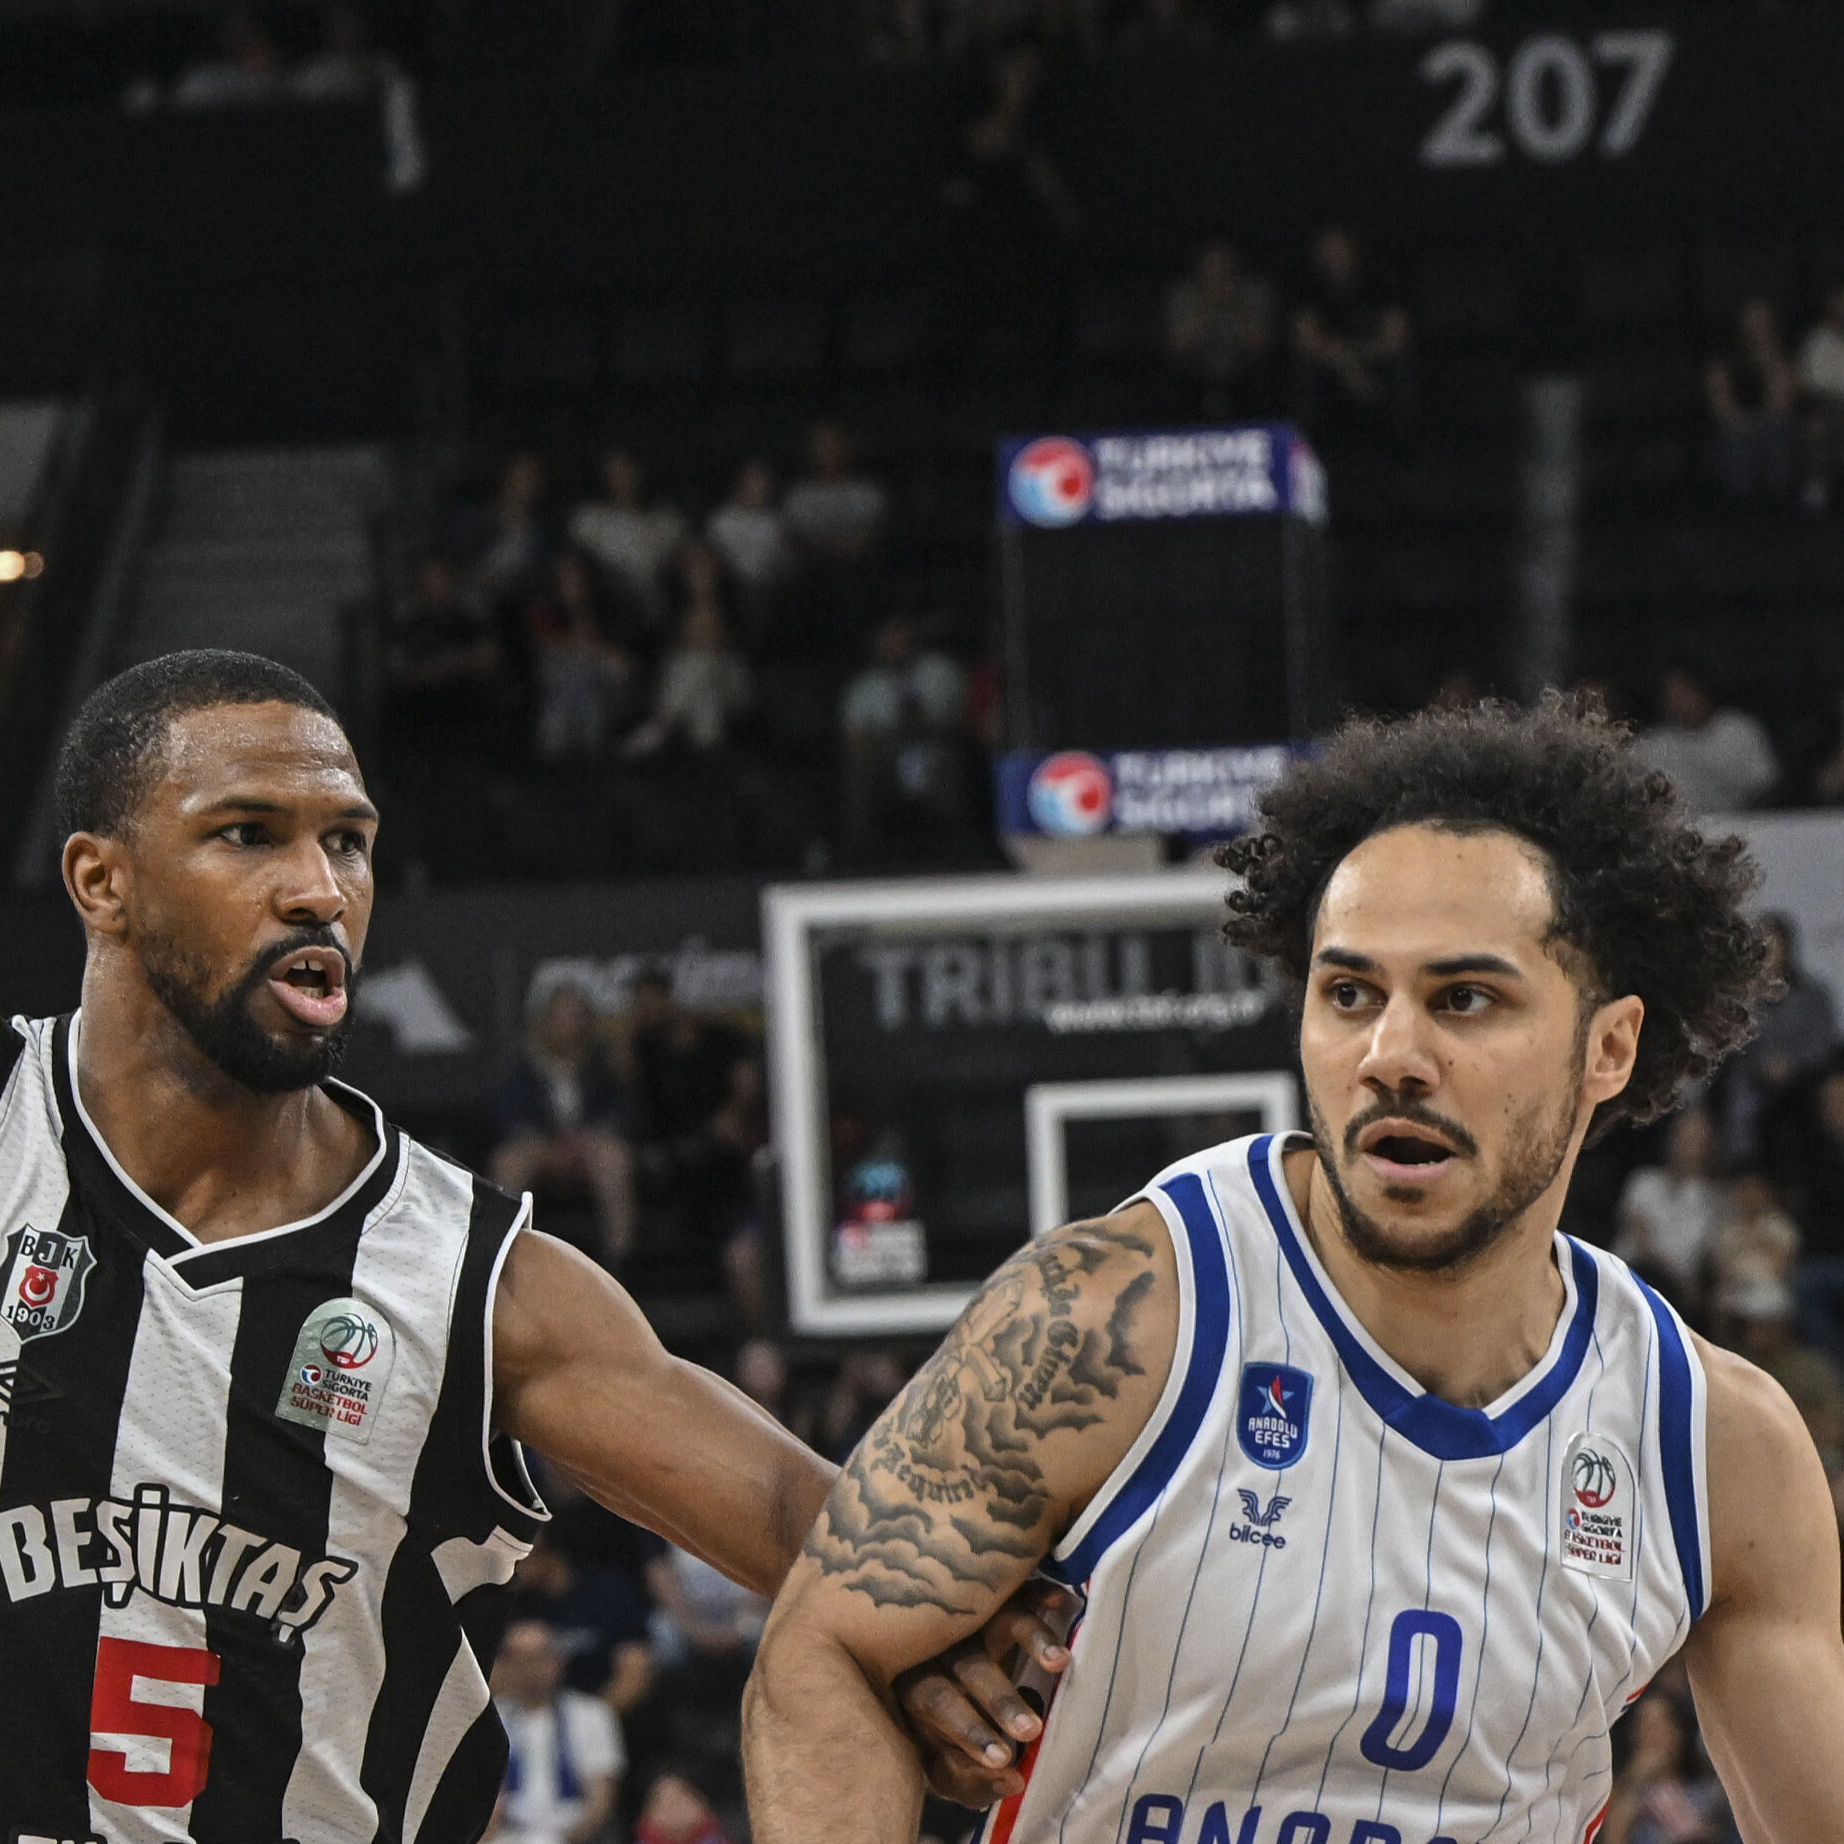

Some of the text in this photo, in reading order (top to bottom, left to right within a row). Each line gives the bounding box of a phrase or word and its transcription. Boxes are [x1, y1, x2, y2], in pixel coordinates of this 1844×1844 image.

[1419, 33, 1674, 168] 207
[19, 1234, 78, 1270] BJK
[5, 1304, 56, 1331] 1903
[292, 1382, 369, 1416] BASKETBOL
[1248, 1415, 1299, 1440] ANADOLU
[1254, 1430, 1291, 1449] EFES
[1229, 1522, 1287, 1550] bilcee
[1360, 1608, 1464, 1771] 0
[86, 1636, 221, 1809] 5
